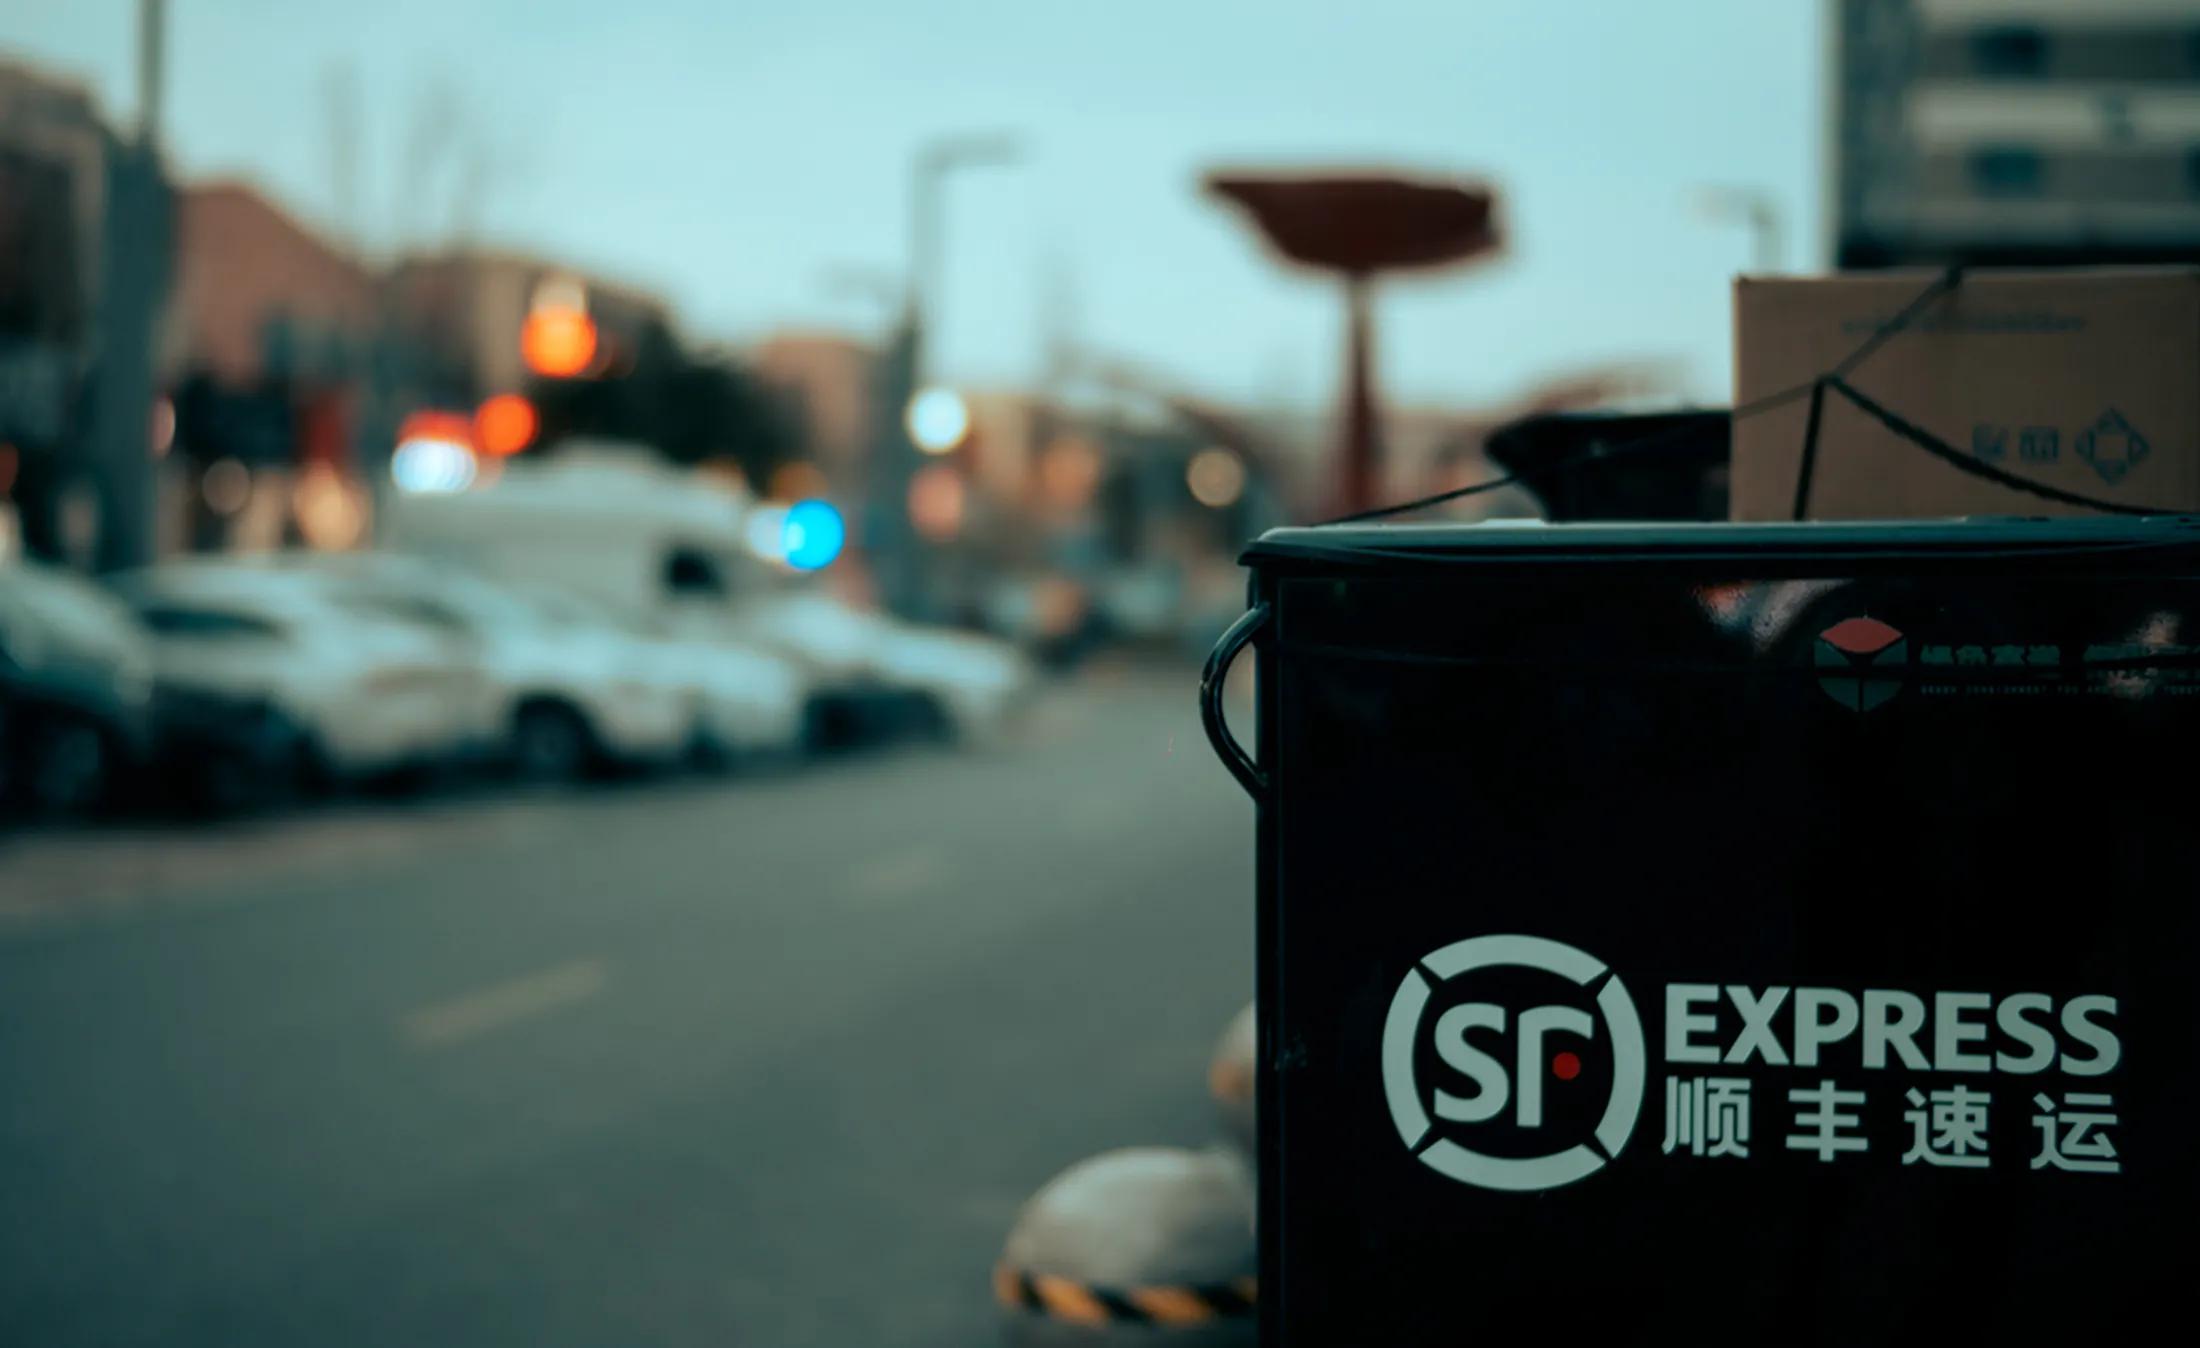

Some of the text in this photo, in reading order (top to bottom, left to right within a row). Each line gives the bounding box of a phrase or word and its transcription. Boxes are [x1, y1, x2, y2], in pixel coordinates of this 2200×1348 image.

[1434, 983, 2121, 1127] SF EXPRESS
[1661, 1076, 2120, 1173] 顺丰速运
